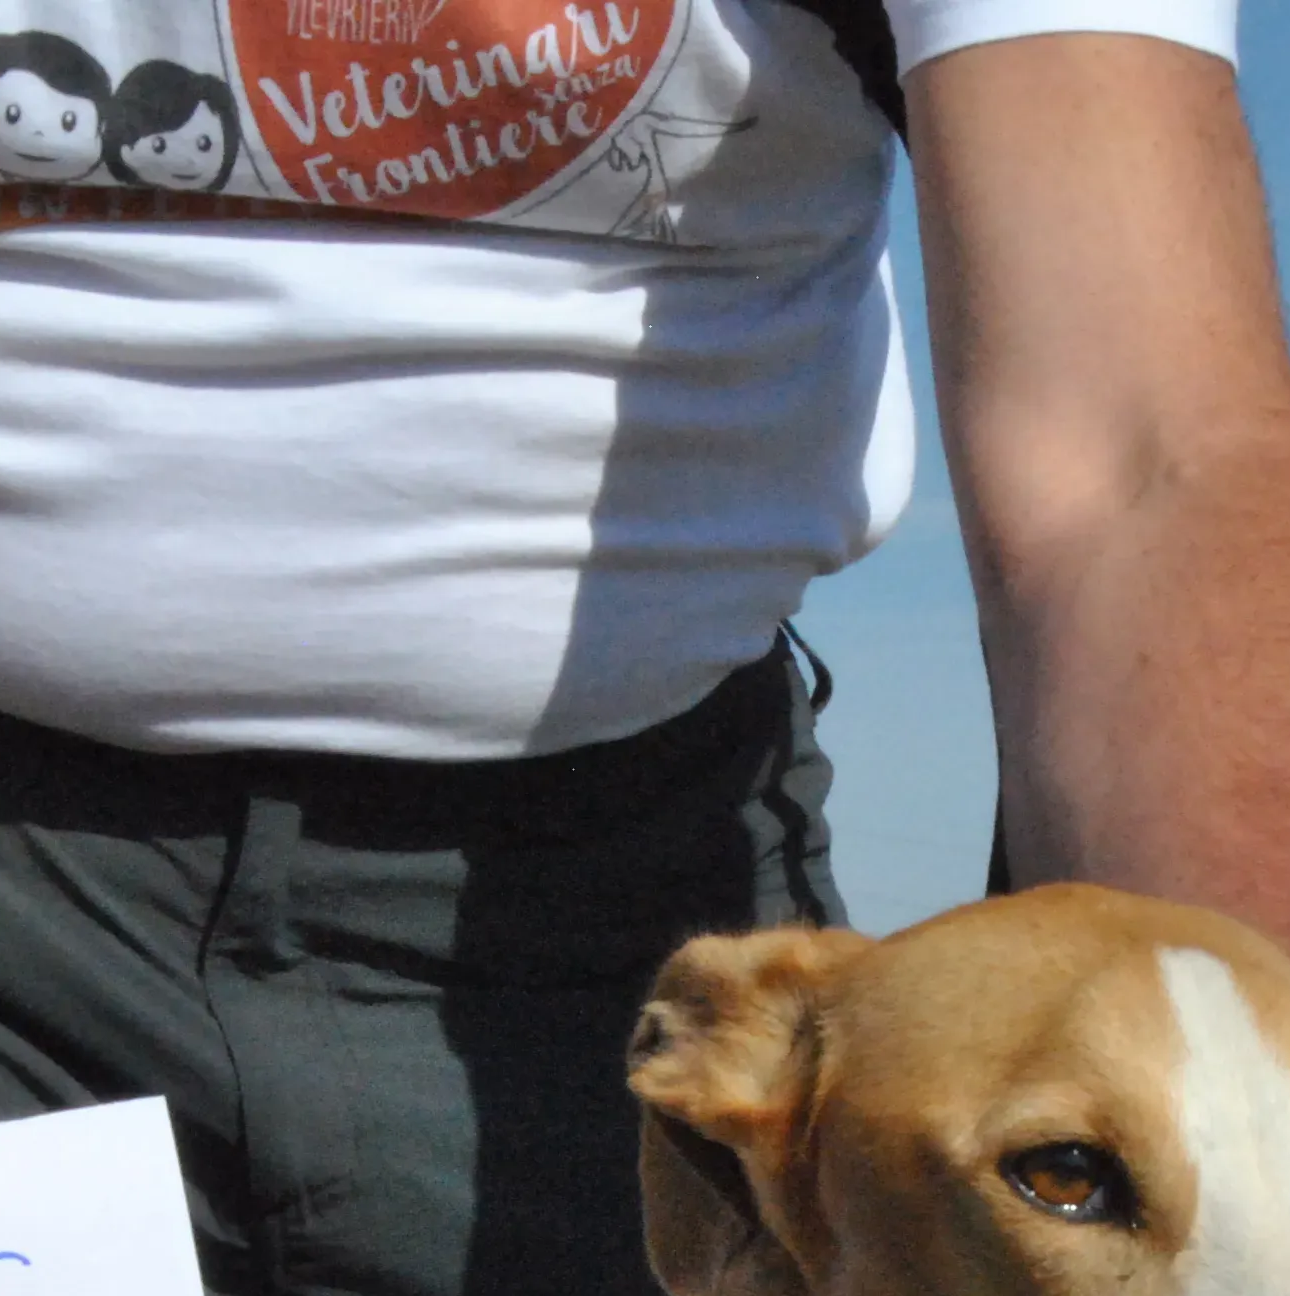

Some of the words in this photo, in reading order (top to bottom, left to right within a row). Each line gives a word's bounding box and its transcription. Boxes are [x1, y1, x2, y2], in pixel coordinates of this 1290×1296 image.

[259, 2, 639, 146] Veterinari
[533, 54, 641, 110] senza
[303, 100, 603, 206] Frontiere
